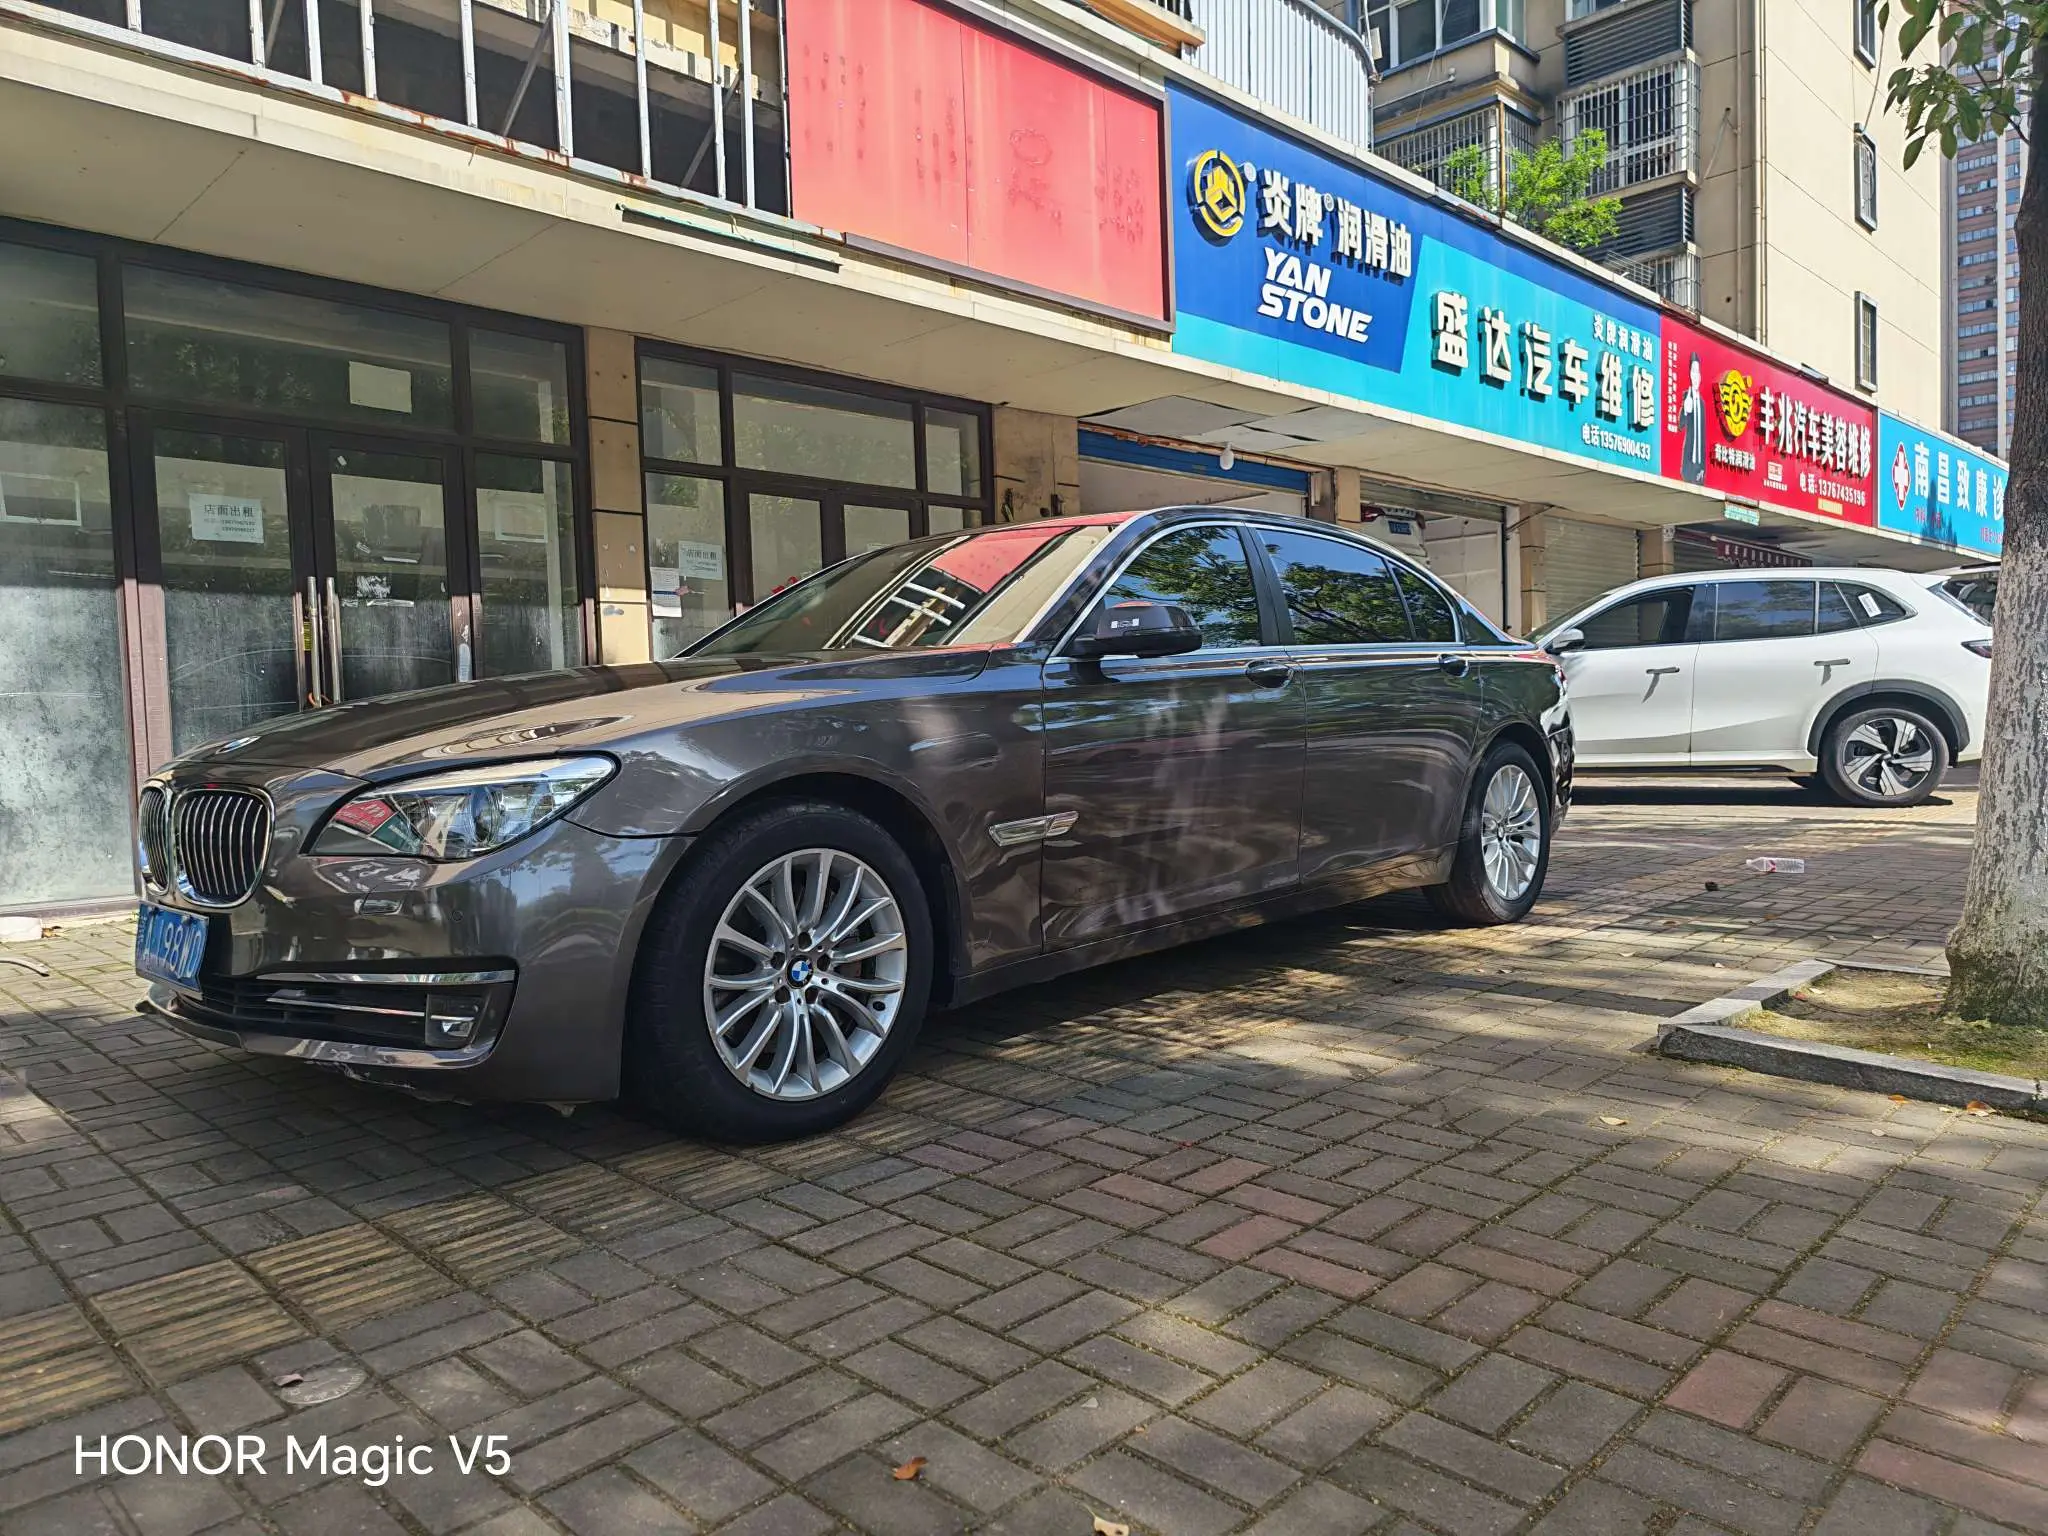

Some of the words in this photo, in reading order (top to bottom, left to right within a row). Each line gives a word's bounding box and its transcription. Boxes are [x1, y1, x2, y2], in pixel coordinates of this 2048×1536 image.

[1264, 247, 1332, 298] YAN
[1257, 283, 1373, 343] STONE
[1593, 314, 1653, 362] 炎牌润滑油
[1434, 290, 1655, 428] 盛达汽车维修
